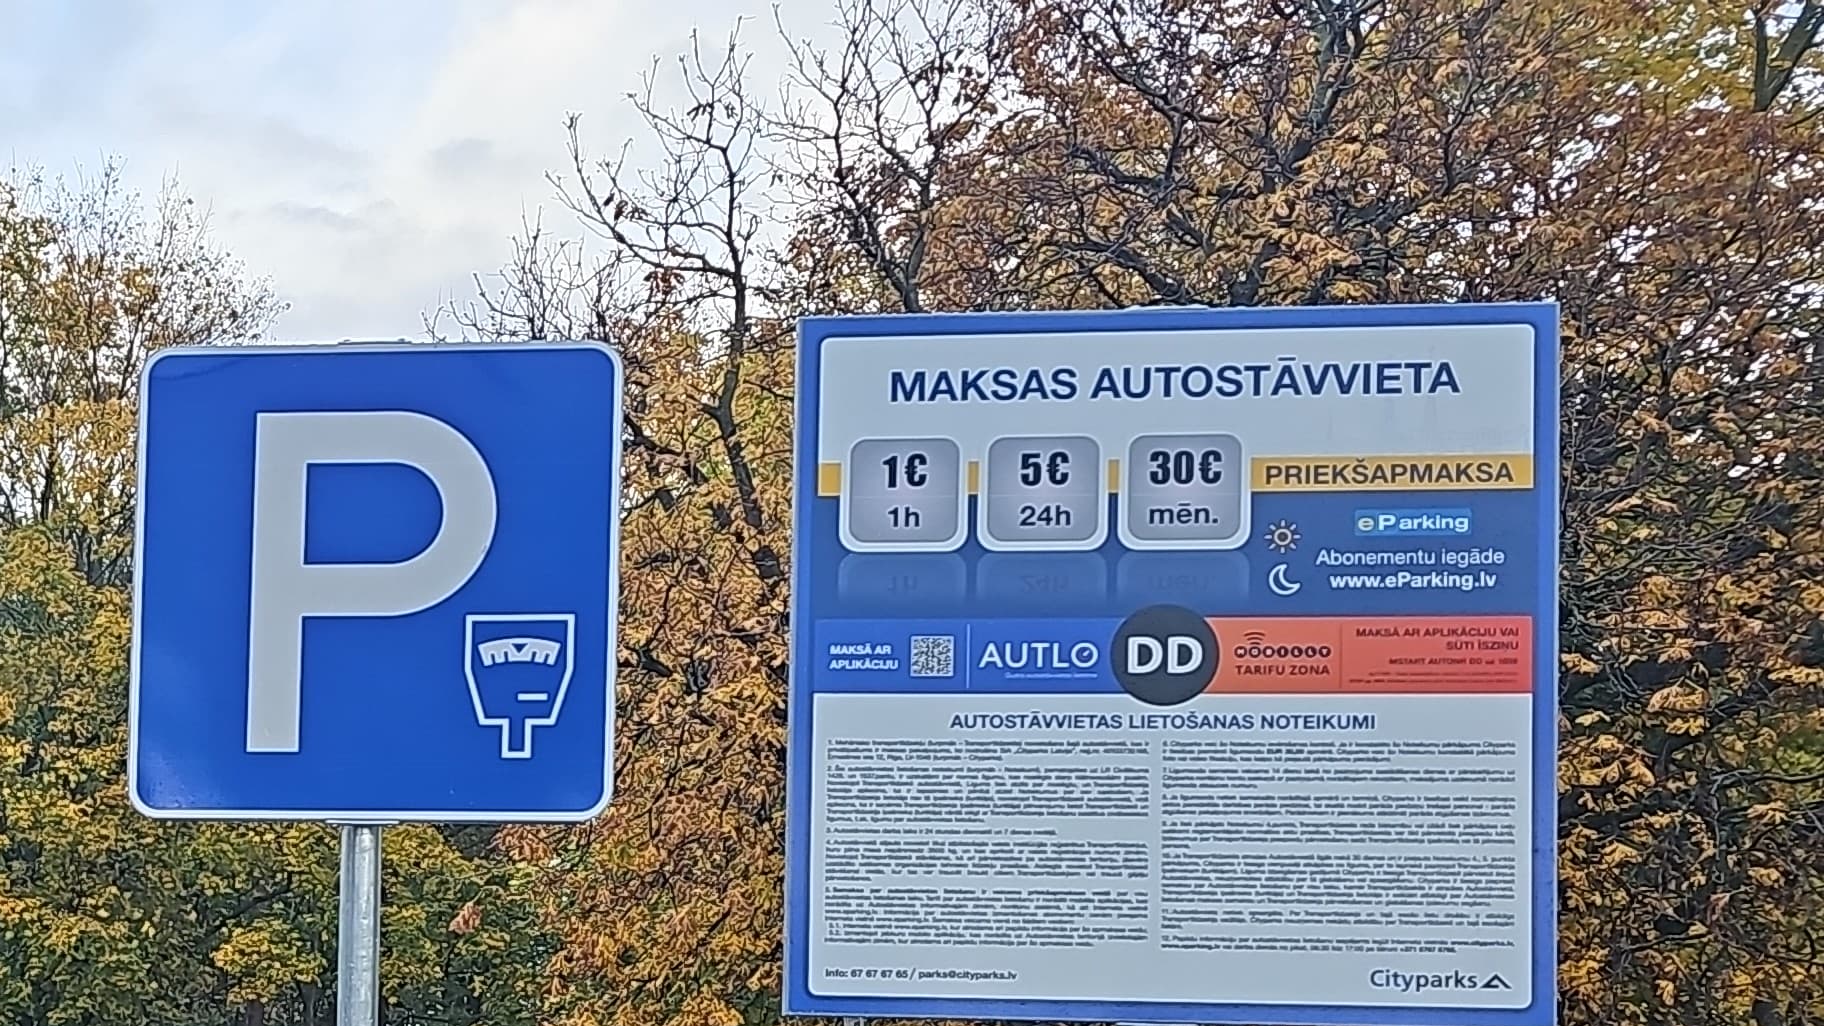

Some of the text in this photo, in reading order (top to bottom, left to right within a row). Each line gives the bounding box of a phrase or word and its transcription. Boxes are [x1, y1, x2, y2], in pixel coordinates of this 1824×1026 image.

[889, 356, 1462, 403] MAKSAS AUTOSTĀVVIETA
[882, 453, 928, 488] 1€
[1020, 451, 1069, 486] 5€
[1149, 449, 1222, 485] 30€
[1264, 458, 1515, 486] PRIEKŠAPMAKSA
[887, 507, 921, 528] 1h
[1018, 504, 1071, 527] 24h
[1148, 502, 1219, 525] mēn.
[1315, 548, 1505, 568] Abonementu iegāde
[246, 410, 497, 753] P
[1329, 572, 1497, 591] www.eParking.lv
[1403, 627, 1420, 637] AR
[1500, 627, 1519, 637] VAI
[830, 642, 892, 655] MAKSĀ AR
[978, 642, 1099, 669] AUTLO
[1126, 635, 1204, 675] DD
[829, 657, 899, 670] APLIKĀCIJU
[1235, 664, 1331, 676] TARIFU ZONA
[950, 711, 1376, 729] AUTOSTĀVVIETAS LIETOŠANAS NOTEIKUMI
[825, 968, 849, 978] Info:
[850, 969, 863, 978] 67
[865, 969, 878, 978] 67
[1370, 969, 1478, 992] Cityparks
